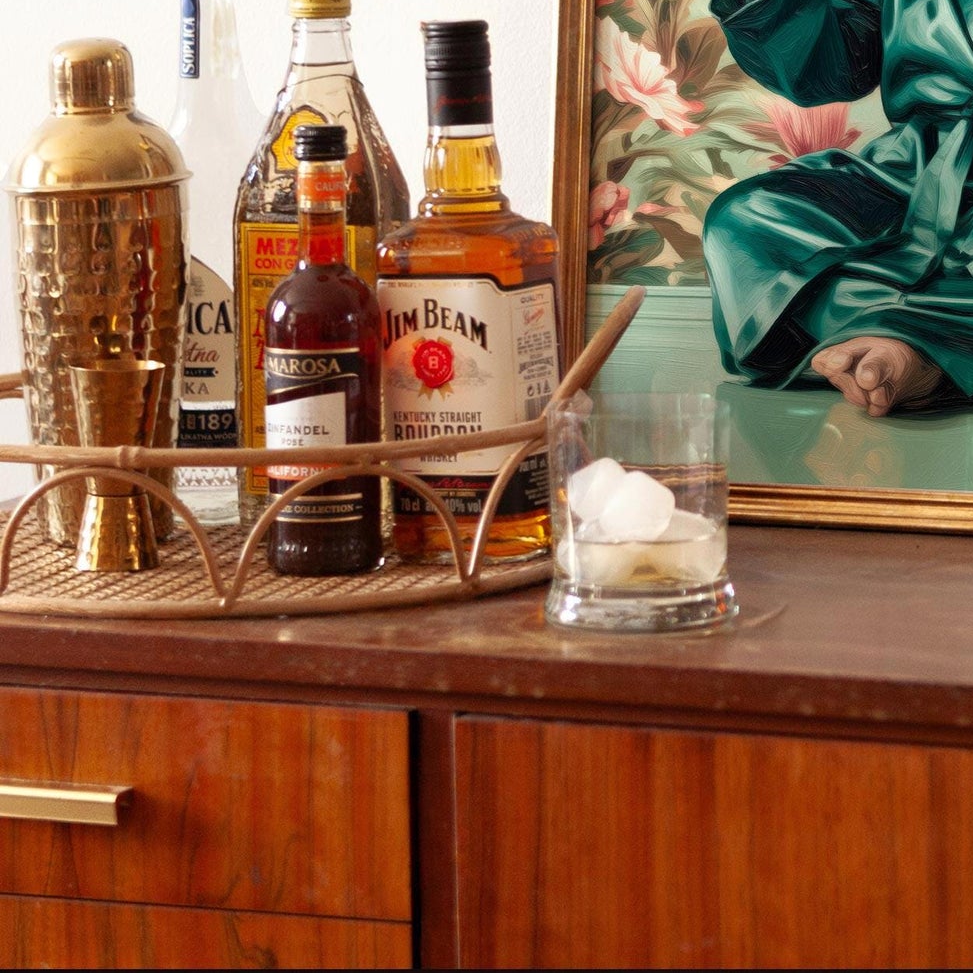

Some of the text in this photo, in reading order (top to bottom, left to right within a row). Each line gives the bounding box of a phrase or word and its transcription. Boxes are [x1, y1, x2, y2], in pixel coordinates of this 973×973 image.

[182, 16, 196, 75] SOPLICA
[256, 238, 298, 256] MEZ
[255, 258, 281, 269] CON
[186, 299, 233, 335] ICA
[383, 308, 419, 352] JIM
[423, 298, 489, 352] BEAM
[184, 341, 220, 363] tna
[267, 357, 342, 375] MAROSA
[184, 382, 210, 395] KA
[198, 413, 234, 430] 189
[393, 411, 482, 423] KENTUCKY STRAIGHT
[294, 504, 354, 514] COLLECTION
